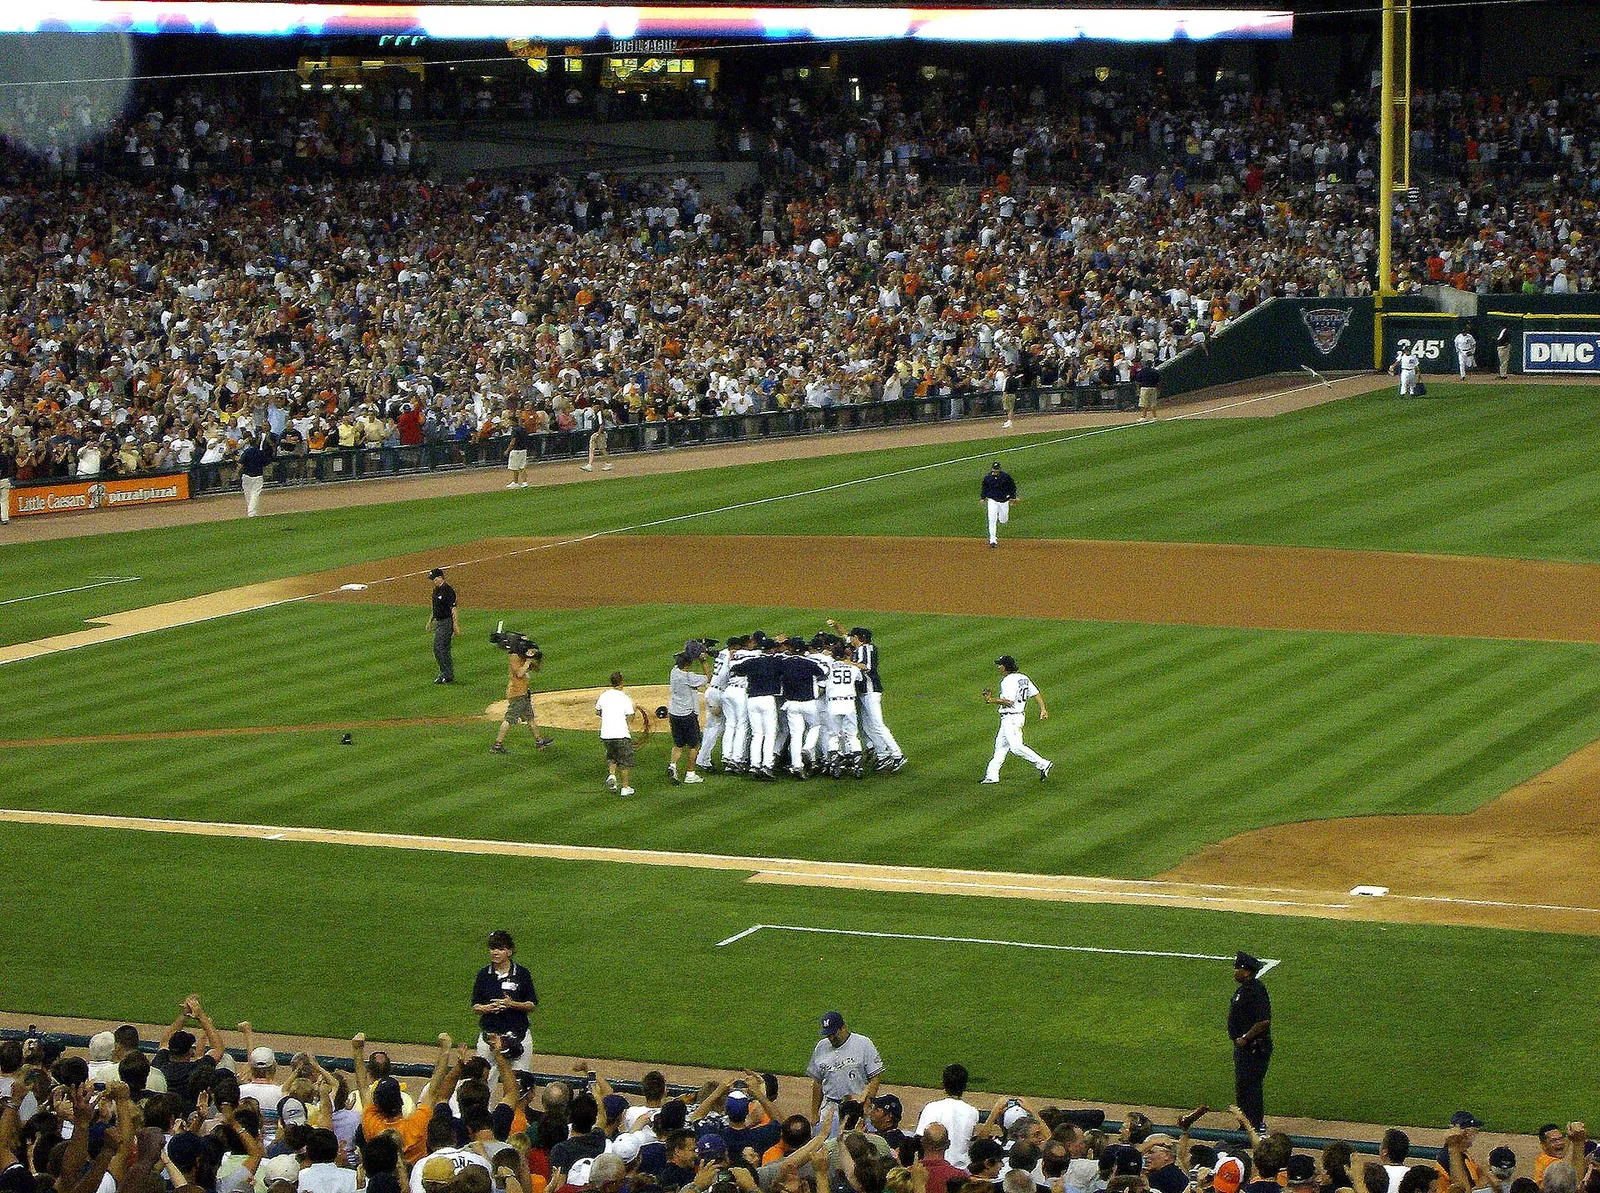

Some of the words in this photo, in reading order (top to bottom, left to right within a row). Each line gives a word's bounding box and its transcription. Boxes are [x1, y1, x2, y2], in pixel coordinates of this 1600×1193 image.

[1530, 343, 1594, 363] DMC
[18, 495, 46, 512] Little
[47, 493, 86, 509] Caesars
[833, 669, 851, 684] 58
[849, 1070, 855, 1080] 6
